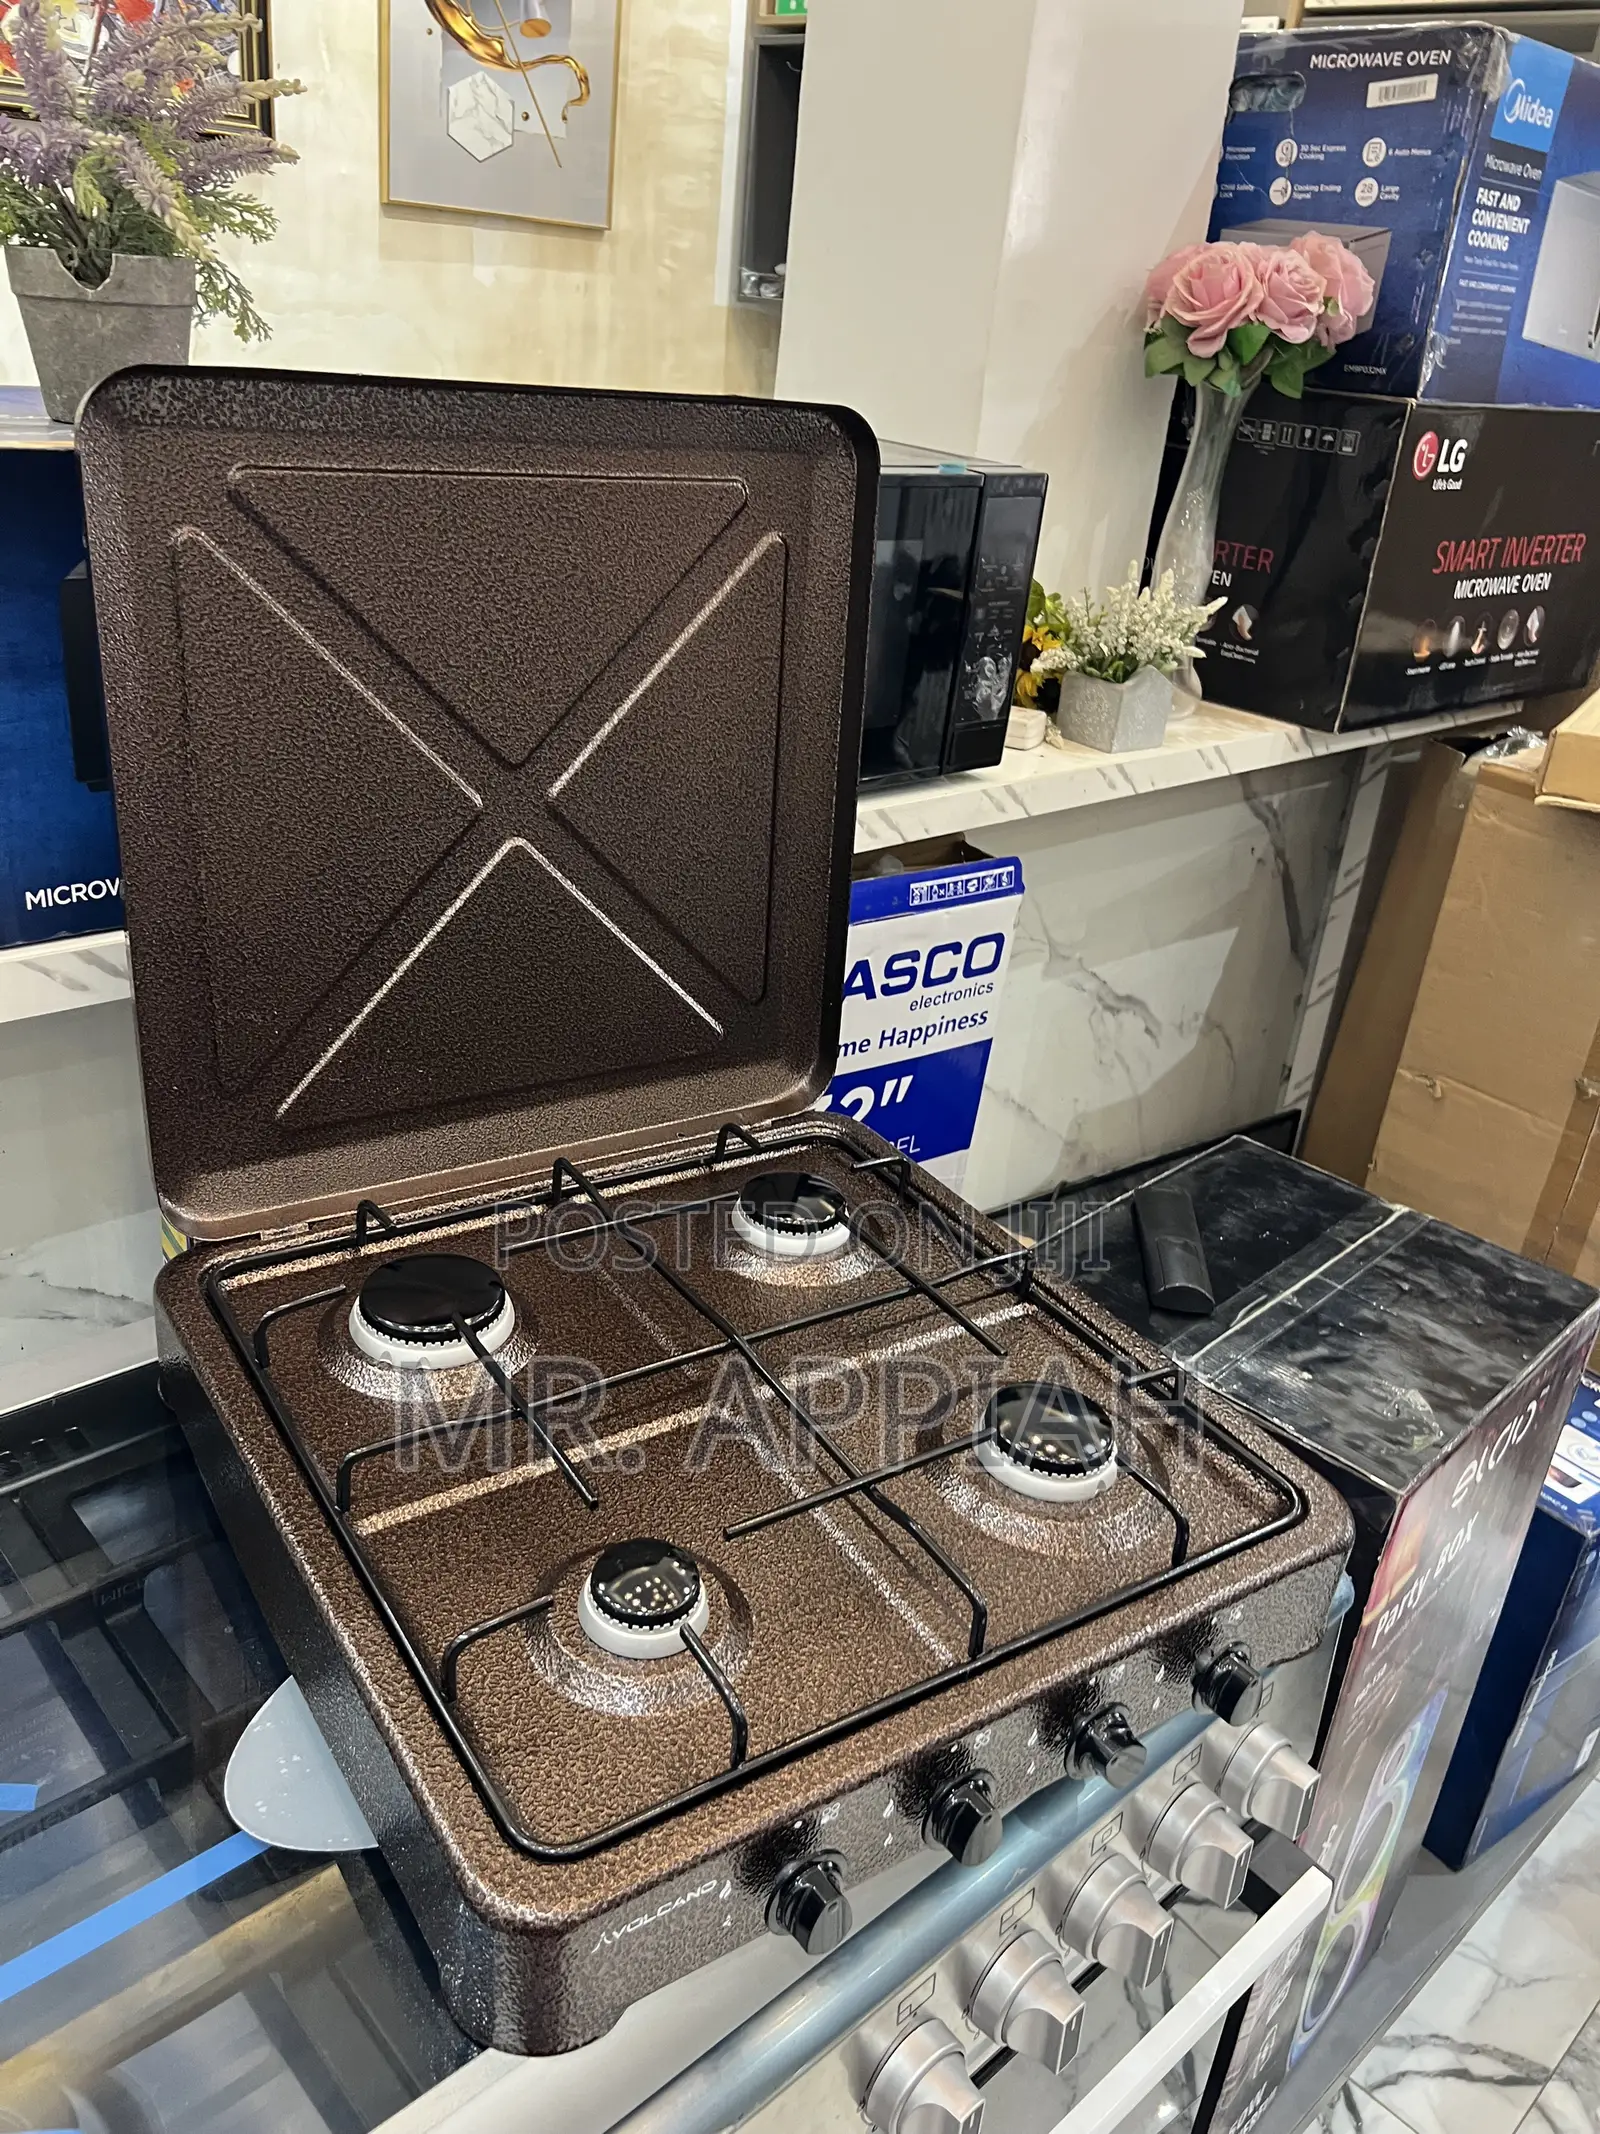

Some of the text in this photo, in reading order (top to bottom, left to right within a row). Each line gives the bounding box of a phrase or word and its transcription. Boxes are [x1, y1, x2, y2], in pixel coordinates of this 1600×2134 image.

[1310, 49, 1452, 69] MICROWAVE OVEN
[1503, 78, 1554, 129] Midea
[1299, 152, 1324, 160] Cooking
[1484, 153, 1543, 182] Microwave Oven
[1475, 187, 1521, 212] FAST AND
[1472, 208, 1531, 234] CONVENIENT
[1467, 229, 1510, 252] COOKING
[1437, 438, 1469, 473] LG
[1432, 478, 1463, 490] Life's Good
[1432, 533, 1587, 575] SMART INVERTER
[1453, 572, 1552, 600] MICROWAVE OVEN
[909, 982, 994, 1011] electronics
[878, 1010, 989, 1049] Happiness
[1371, 1567, 1432, 1650] Party
[1433, 1511, 1480, 1580] BOX
[611, 1879, 717, 1940] VOLCANO
